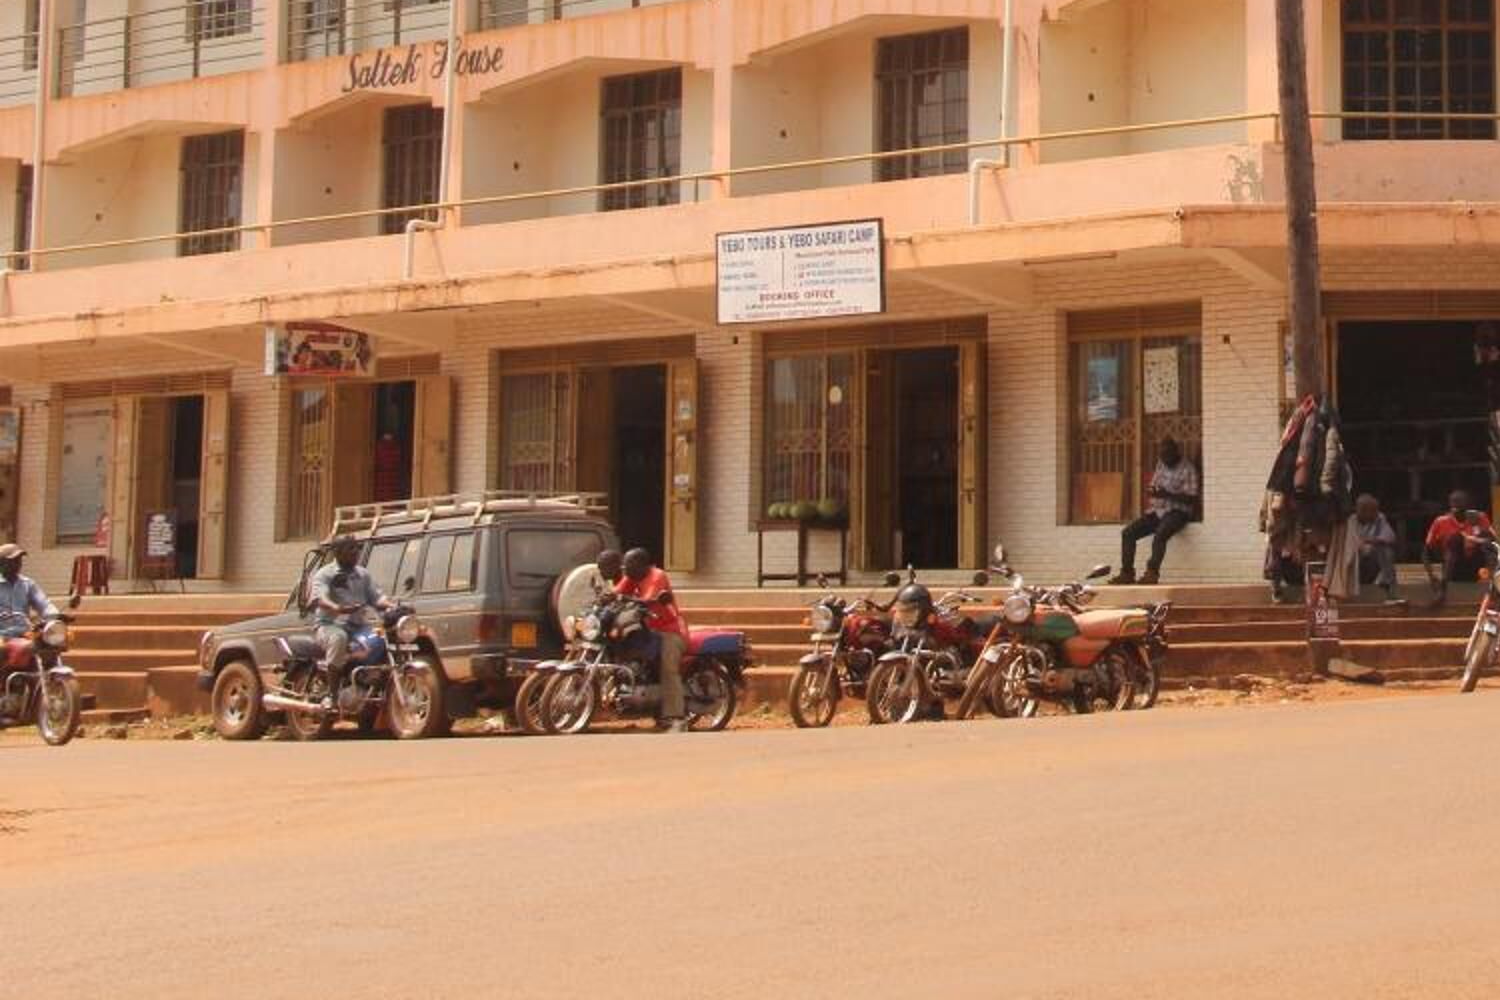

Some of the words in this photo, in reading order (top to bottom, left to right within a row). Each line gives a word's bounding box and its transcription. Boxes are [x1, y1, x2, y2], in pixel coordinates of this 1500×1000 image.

[341, 43, 423, 93] Saltek
[430, 36, 504, 78] House
[747, 236, 777, 251] TOURS
[787, 233, 812, 249] YEBO
[815, 230, 847, 246] SAFARI
[848, 227, 875, 242] CAMP
[759, 290, 799, 301] BOOKING
[803, 288, 835, 300] OFFICE
